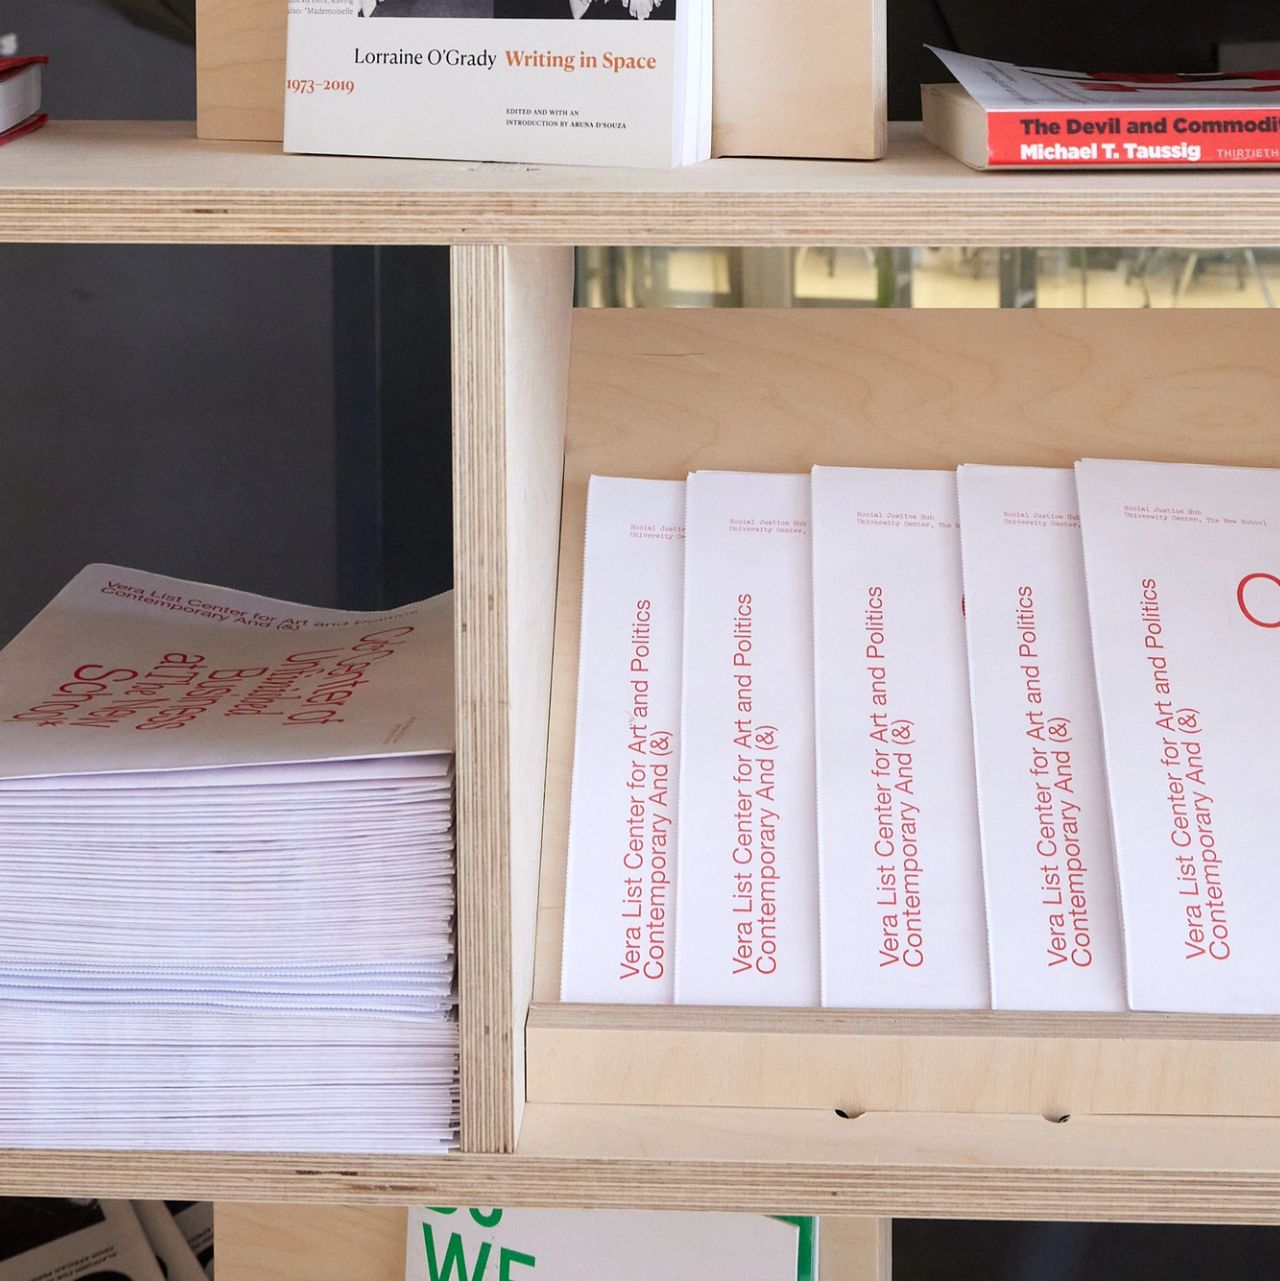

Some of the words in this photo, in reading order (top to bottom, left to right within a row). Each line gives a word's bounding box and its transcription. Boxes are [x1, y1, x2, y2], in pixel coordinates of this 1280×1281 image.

[354, 48, 423, 65] Lorraine
[427, 49, 497, 70] O'Grady
[505, 49, 576, 72] Writing
[580, 51, 597, 69] in
[602, 51, 657, 73] Space
[506, 120, 558, 128] INTRODUCTION
[559, 120, 569, 128] BY
[570, 121, 594, 129] ARUNA
[533, 108, 548, 116] AND
[549, 108, 568, 117] WITH
[569, 109, 580, 117] AN
[1021, 119, 1061, 135] The
[1067, 118, 1120, 135] Devil
[1127, 118, 1168, 134] and
[1020, 142, 1098, 160] Michael
[1101, 143, 1120, 160] T.
[1123, 142, 1201, 161] Taussig
[1217, 148, 1279, 158] THIRTIETH
[1140, 578, 1165, 649] Politics
[1147, 657, 1170, 695] and
[1155, 700, 1175, 732] Art
[1177, 707, 1201, 735] (&)
[1160, 737, 1180, 769] for
[1185, 740, 1207, 785] And
[1167, 772, 1192, 848] Center
[1178, 855, 1198, 897] List
[1195, 792, 1230, 961] Contemporary
[1184, 904, 1207, 960] Vera
